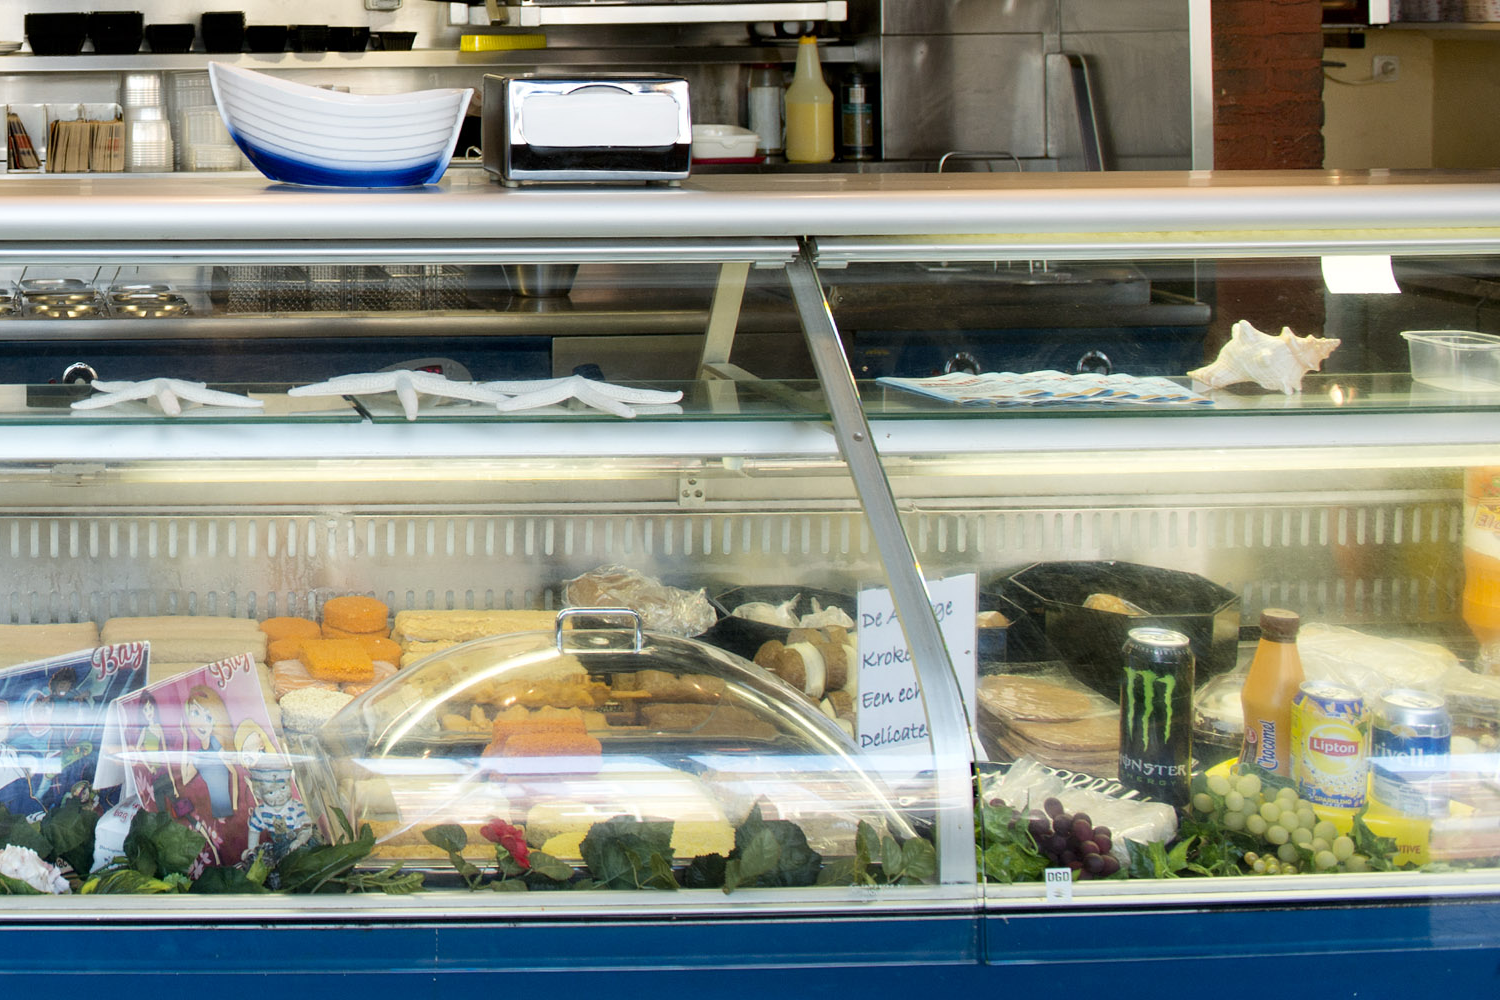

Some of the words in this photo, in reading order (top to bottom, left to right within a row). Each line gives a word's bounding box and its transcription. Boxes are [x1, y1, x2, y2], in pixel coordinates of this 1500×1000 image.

[863, 613, 882, 628] De
[863, 646, 911, 669] Kroke
[862, 691, 893, 709] Een
[1257, 720, 1276, 771] Chocomel
[1314, 738, 1356, 754] Lipton
[1048, 872, 1069, 881] DGD
